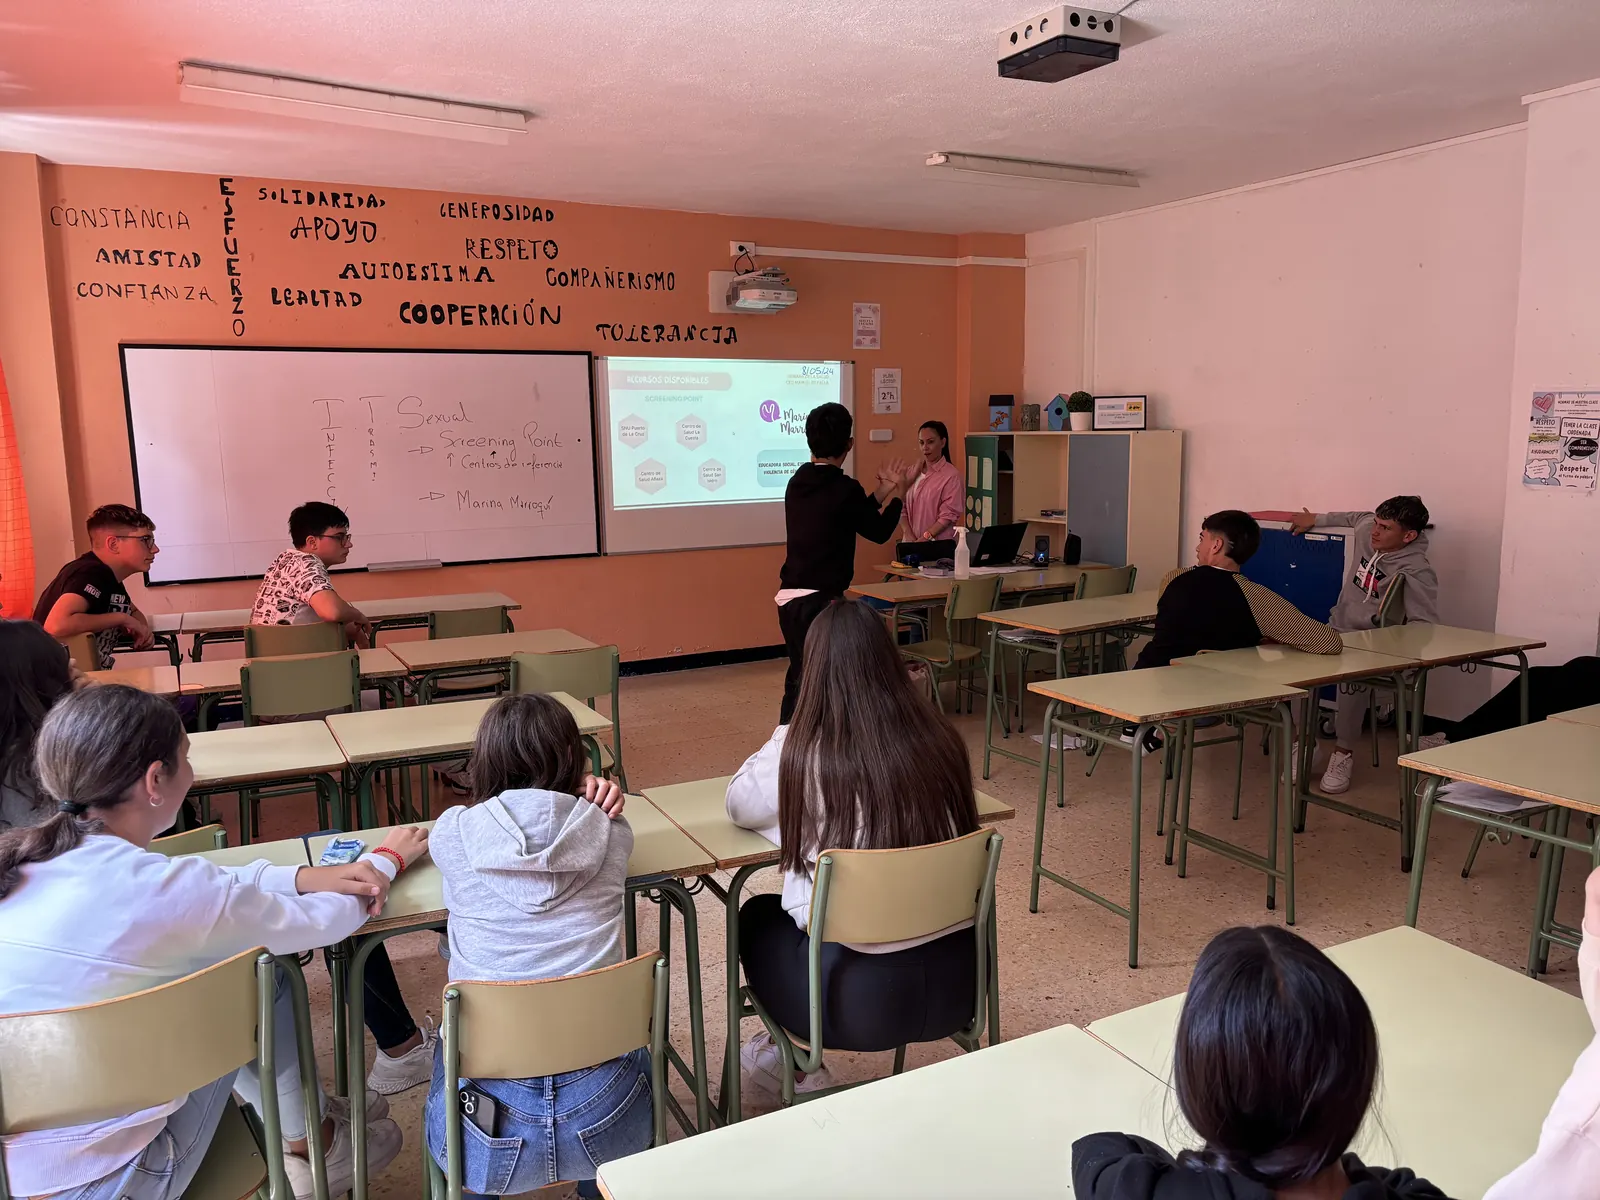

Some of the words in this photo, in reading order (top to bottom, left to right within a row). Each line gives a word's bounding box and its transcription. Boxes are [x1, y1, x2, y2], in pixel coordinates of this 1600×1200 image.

[50, 206, 190, 230] CONSTANCIA
[439, 201, 554, 223] GENEROSIDAD
[289, 215, 378, 244] APOYO
[95, 247, 202, 269] AMISTAD
[465, 237, 559, 261] RESPETO
[338, 260, 495, 284] AUTOESTIMA
[76, 281, 214, 303] CONFIANZA
[271, 286, 363, 308] LEALTAD
[595, 323, 738, 345] TOLERANCIA
[626, 375, 662, 385] RECURSOS
[523, 420, 563, 448] Point
